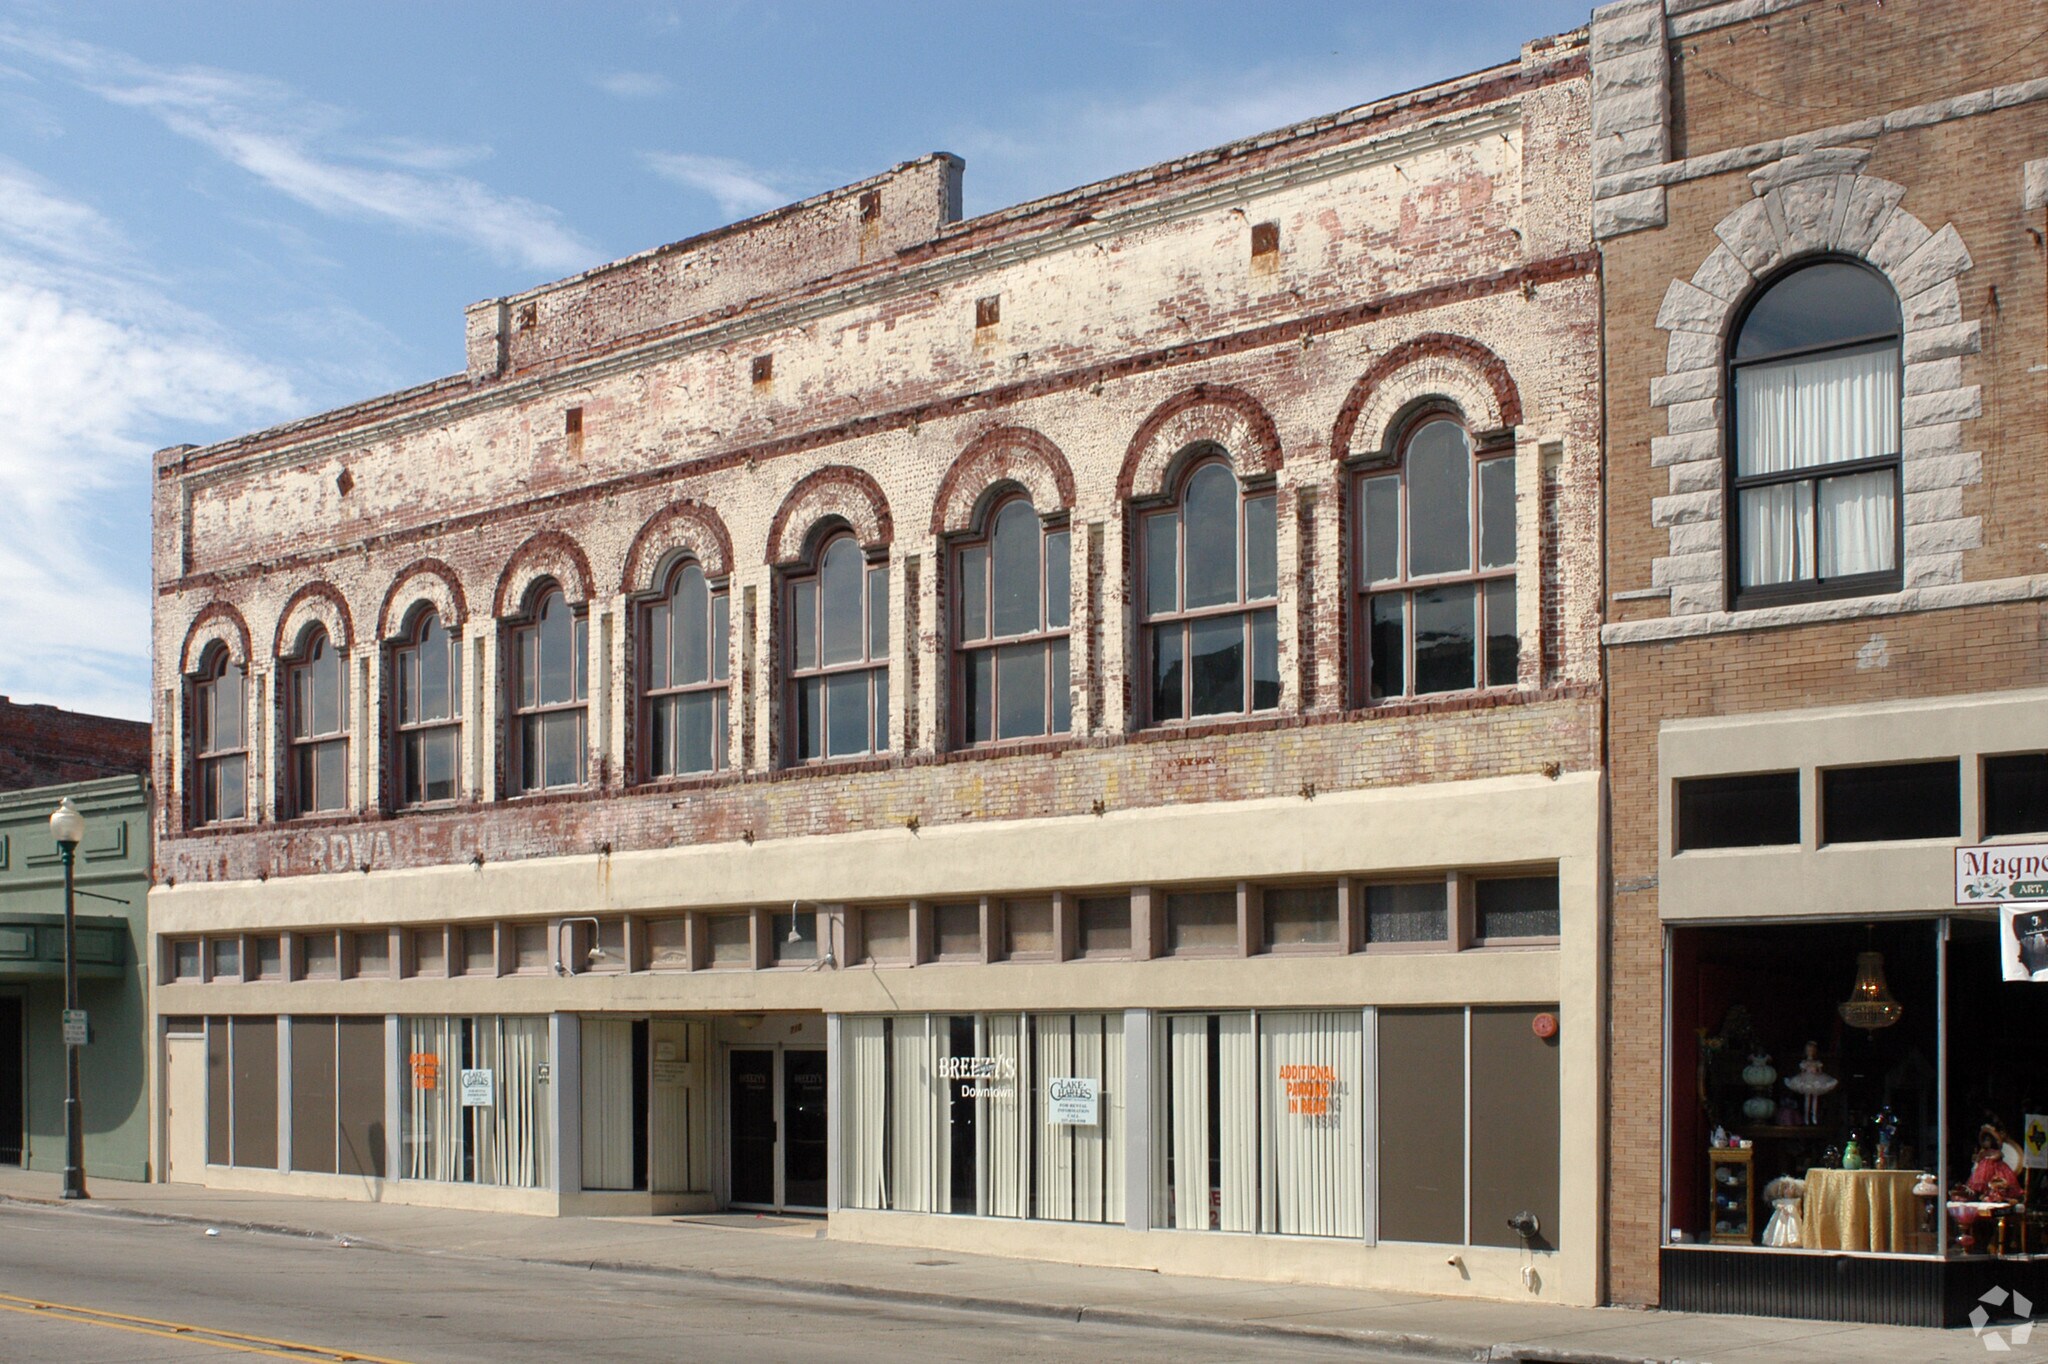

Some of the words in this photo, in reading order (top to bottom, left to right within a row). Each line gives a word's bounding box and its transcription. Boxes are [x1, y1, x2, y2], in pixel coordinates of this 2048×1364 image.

[1279, 1065, 1335, 1080] ADDITIONAL
[961, 1084, 1014, 1098] Downtown
[1286, 1081, 1329, 1098] PARKING
[1288, 1099, 1298, 1114] IN
[1301, 1098, 1327, 1116] REAR
